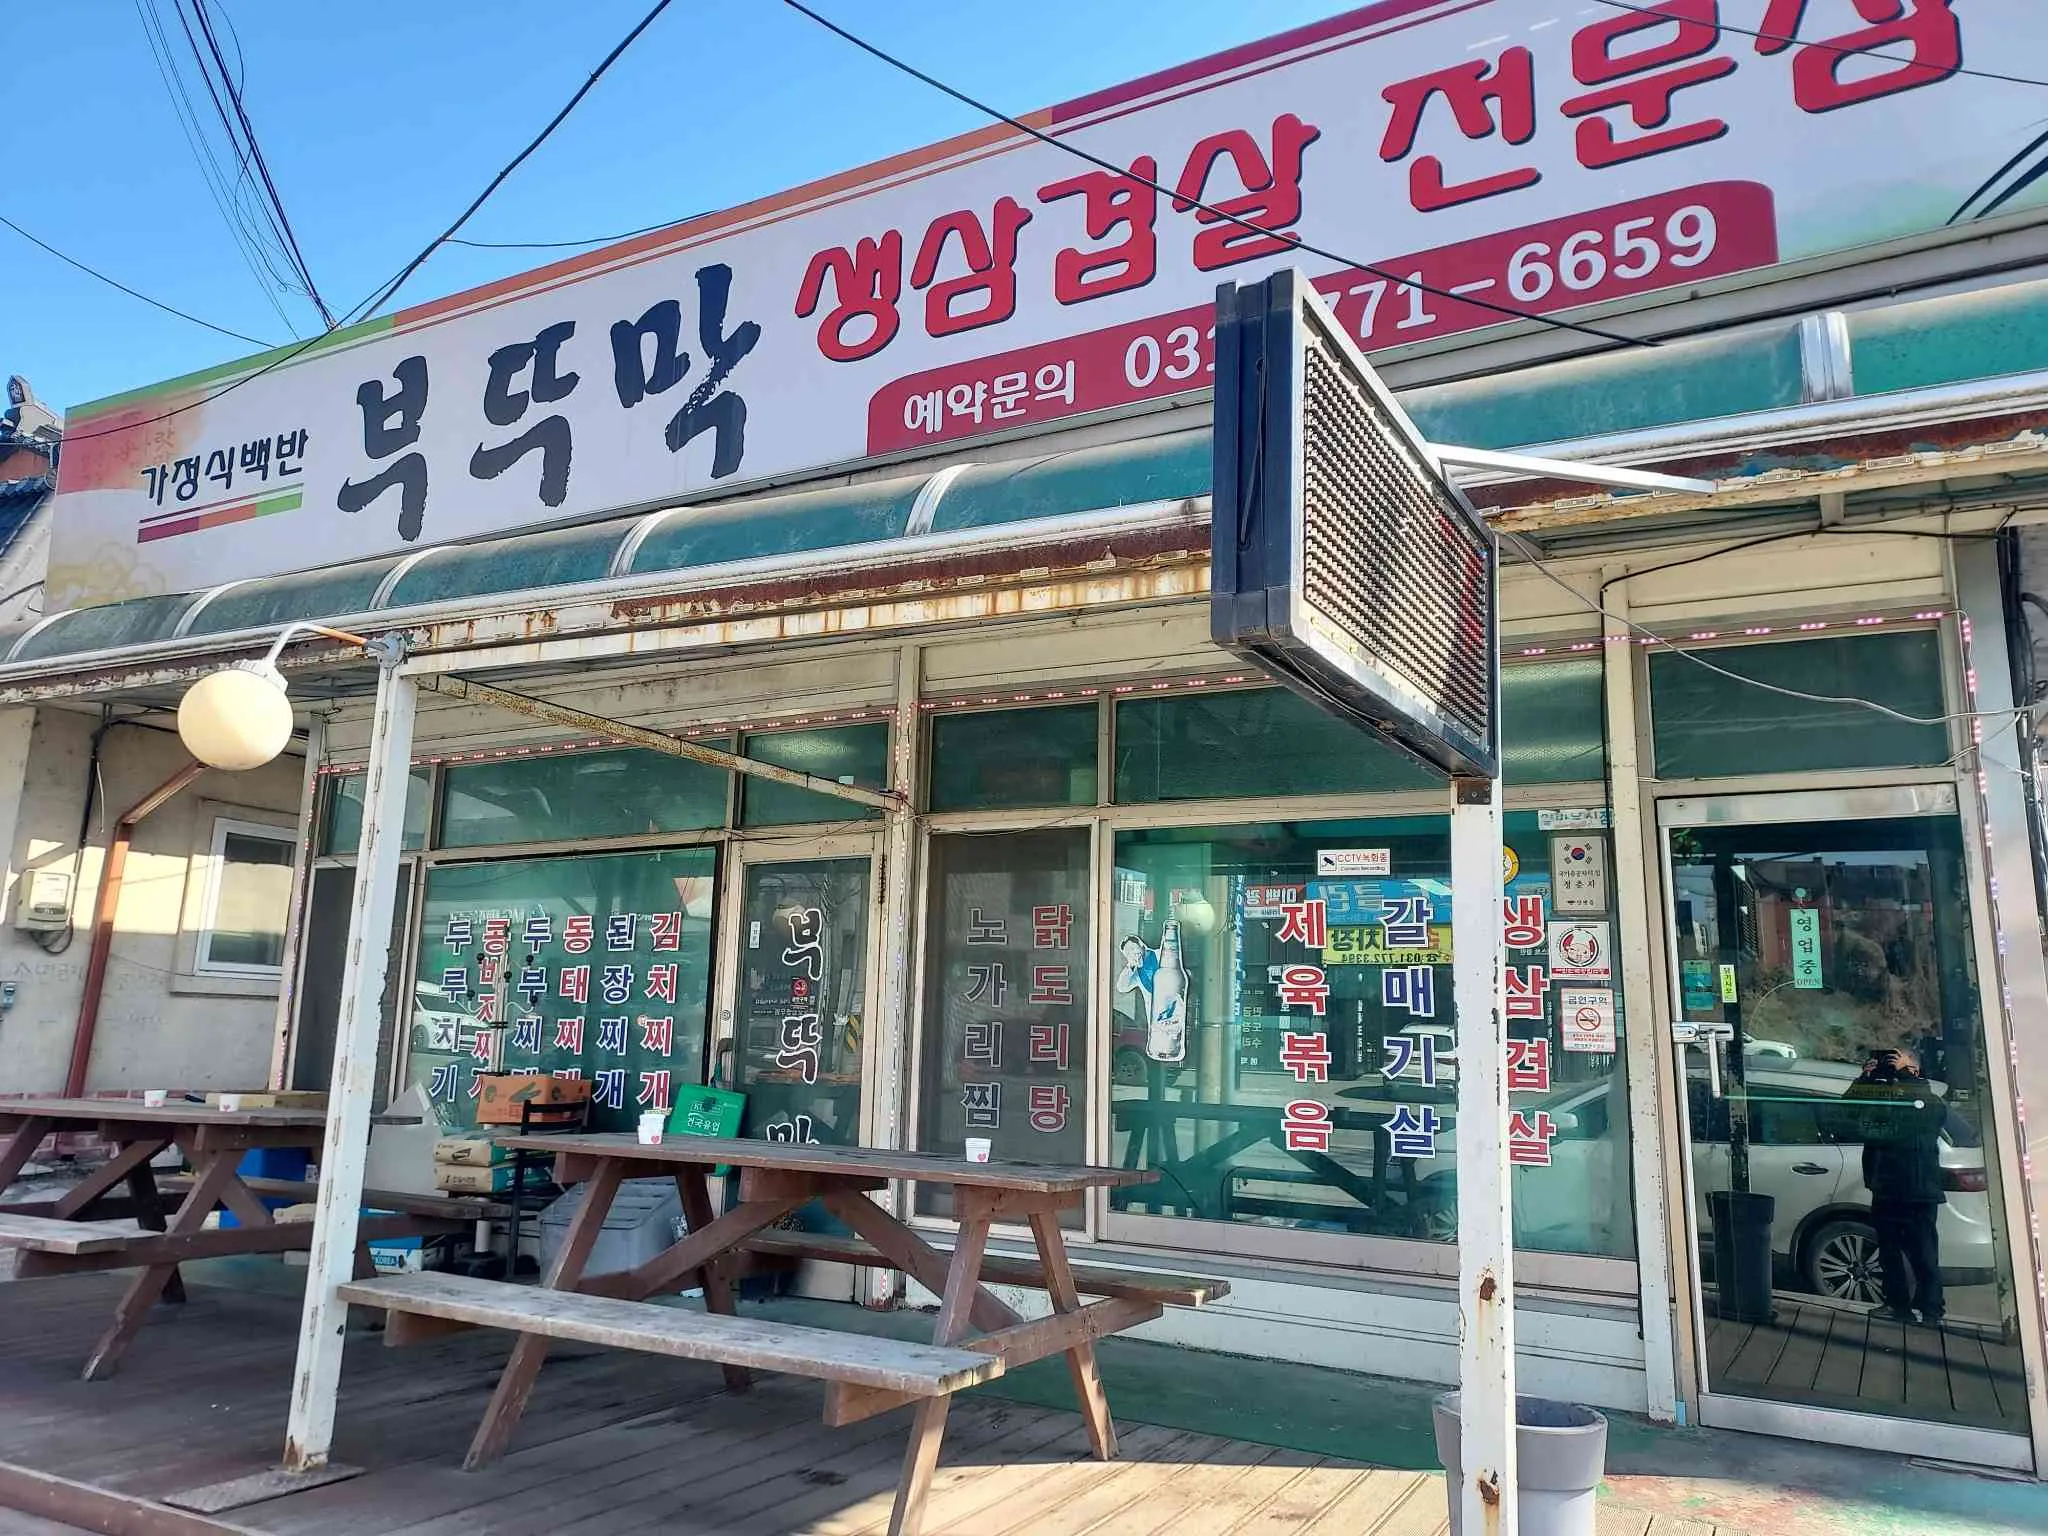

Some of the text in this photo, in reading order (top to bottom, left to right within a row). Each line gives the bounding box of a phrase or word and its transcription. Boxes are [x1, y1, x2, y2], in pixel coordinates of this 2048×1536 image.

[794, 113, 1322, 363] 생삼겹살
[140, 428, 310, 506] 가정식백반
[337, 262, 762, 542] 부뚜막
[903, 359, 1076, 434] 예약문의
[428, 919, 475, 1103] 두루치기
[511, 917, 553, 1076] 두부찌
[552, 915, 595, 1081] 동태찌
[592, 913, 637, 1110] 된장찌개
[636, 911, 682, 1111] 김치찌개
[961, 905, 1009, 1129] 노가리찜
[1028, 904, 1075, 1133] 닭도리탕
[1275, 899, 1334, 1153] 제육볶음
[1378, 896, 1441, 1160] 갈매기살
[1502, 894, 1557, 1167] 생삼겹살
[1567, 994, 1609, 1006] 금연구역
